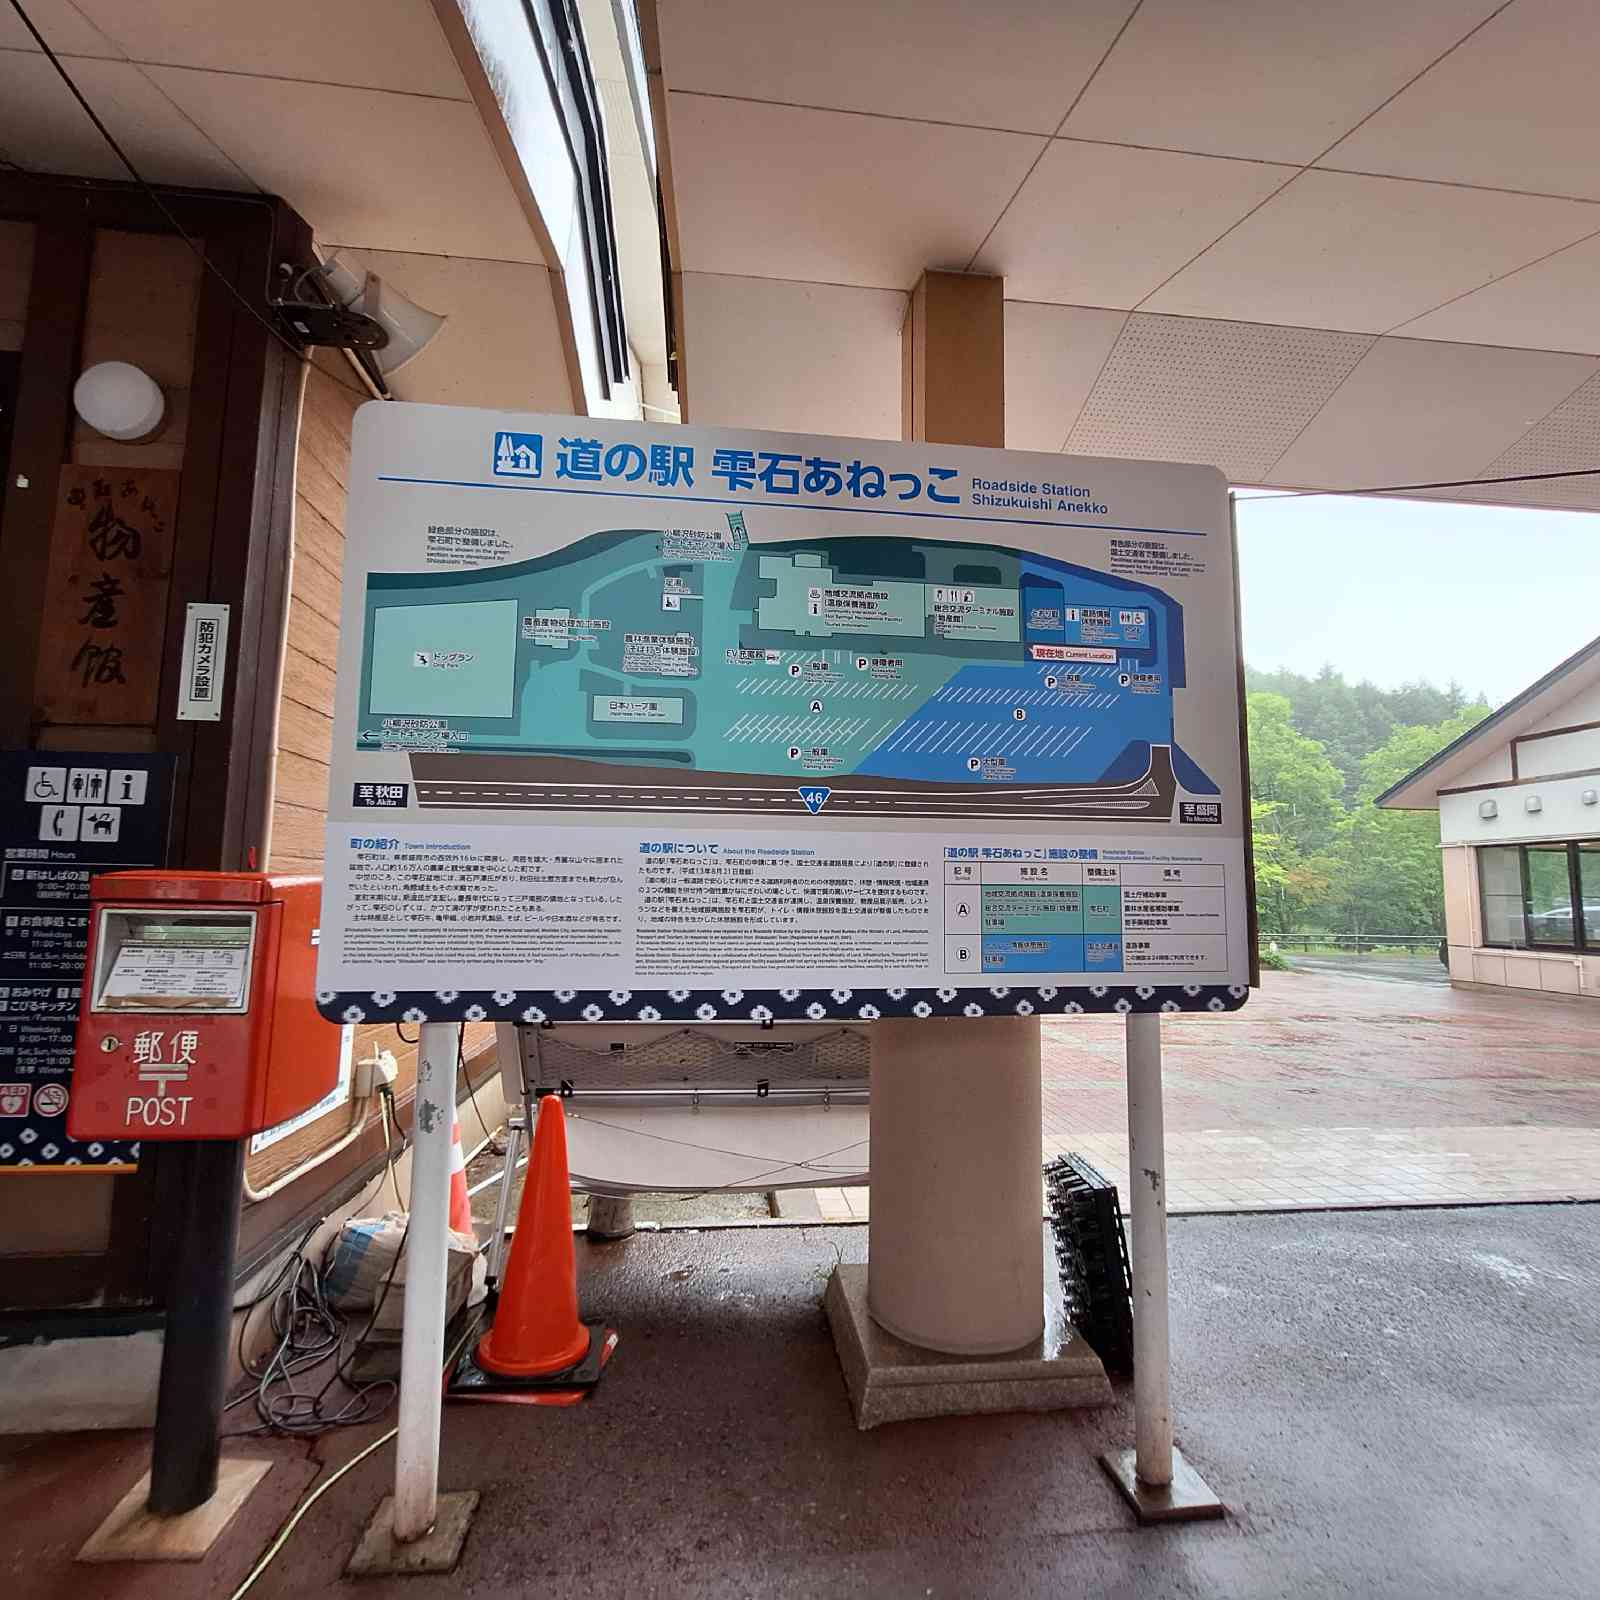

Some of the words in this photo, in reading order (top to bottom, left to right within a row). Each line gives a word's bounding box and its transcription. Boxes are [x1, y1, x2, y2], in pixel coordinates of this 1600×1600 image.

[556, 437, 695, 488] 道の駅
[711, 447, 960, 504] 雫石あねっこ
[972, 478, 1037, 494] Roadside
[1042, 482, 1090, 498] Station
[972, 493, 1052, 510] Shizukuishi
[1057, 499, 1108, 514] Anekko
[1036, 648, 1064, 658] 現在地
[1089, 652, 1114, 660] Location
[193, 621, 214, 699] 防犯カメラ設置
[859, 659, 866, 668] P
[791, 666, 799, 675] P
[812, 702, 820, 711] A
[1017, 710, 1023, 719] B
[790, 748, 798, 758] P
[970, 759, 978, 769] P
[360, 785, 403, 799] 至秋田
[807, 792, 823, 803] 46
[350, 838, 399, 851] 町の紹介
[639, 842, 718, 854] 道の駅について
[958, 904, 968, 915] A
[959, 950, 967, 960] B
[133, 1030, 199, 1064] 郵便
[0, 1086, 27, 1096] AED
[126, 1097, 194, 1126] POST
